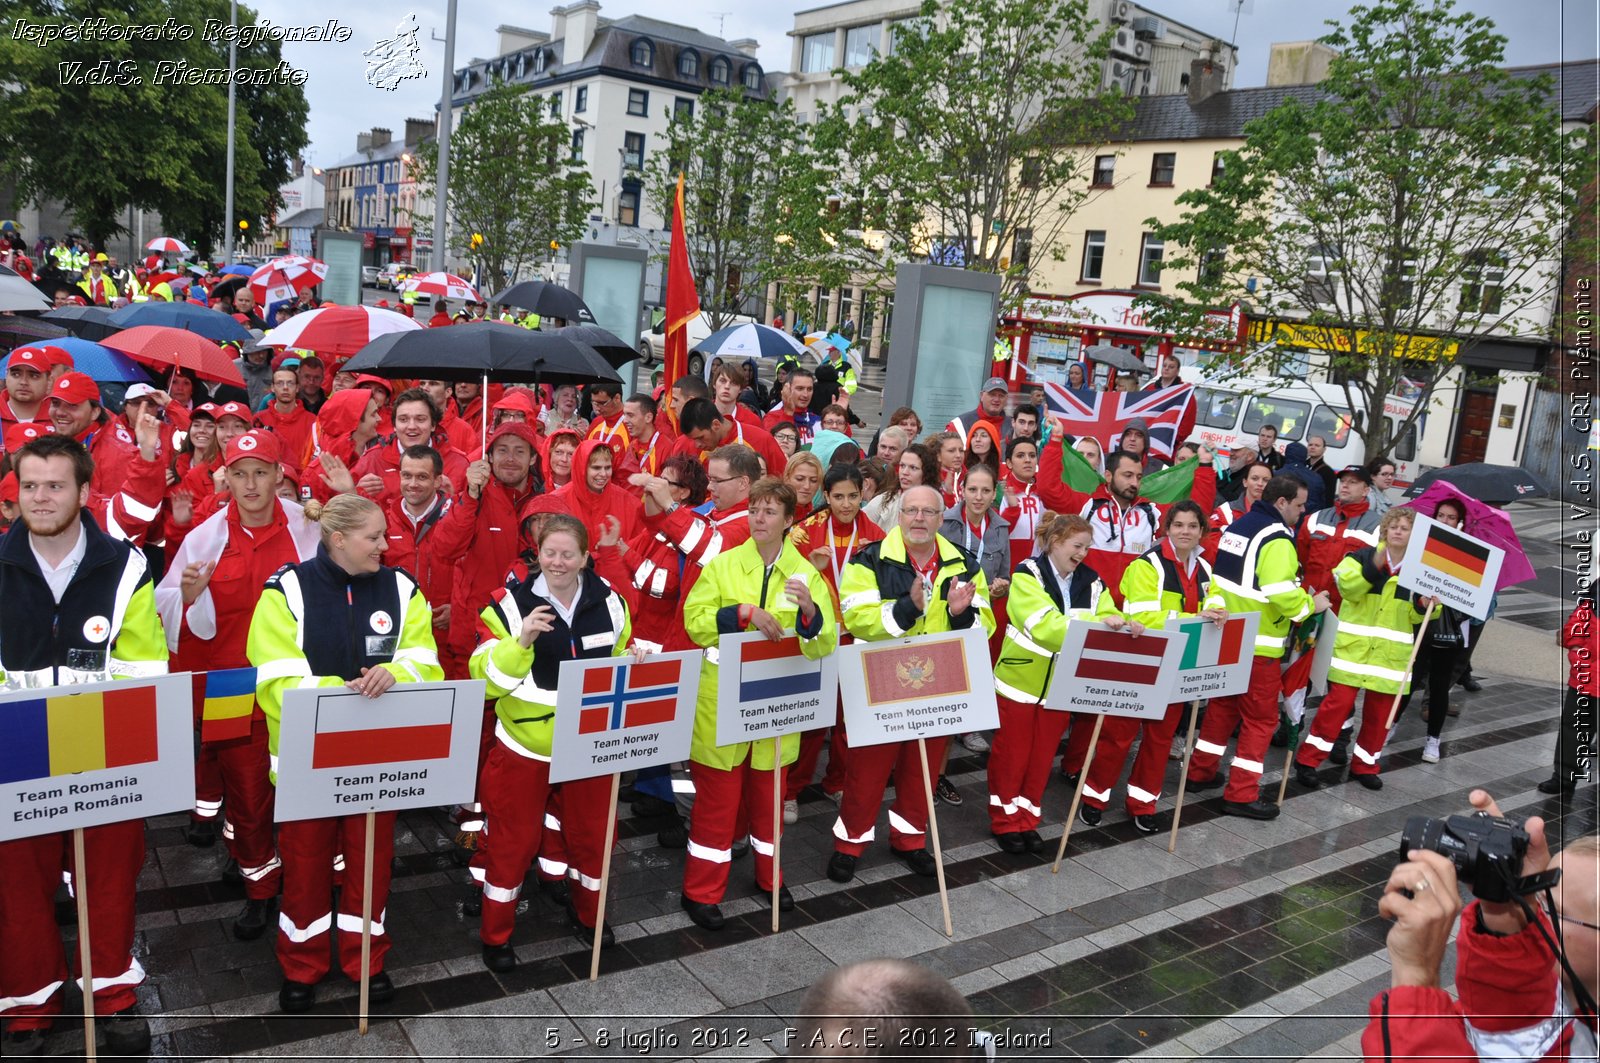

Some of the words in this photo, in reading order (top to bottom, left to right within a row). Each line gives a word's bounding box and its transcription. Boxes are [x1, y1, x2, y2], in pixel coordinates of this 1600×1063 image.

[1200, 431, 1222, 443] IRISH
[1415, 578, 1433, 591] Team
[1434, 585, 1475, 608] Deutschland
[1424, 570, 1442, 583] Team
[1442, 578, 1472, 597] Germany
[1182, 675, 1202, 684] Team
[1204, 671, 1221, 683] Italy
[1085, 685, 1110, 696] Team
[1112, 688, 1138, 699] Latvia
[1180, 686, 1200, 694] Team
[1202, 683, 1219, 693] Italia
[740, 707, 765, 718] Team
[767, 698, 820, 715] Netherlands
[874, 711, 903, 721] Team
[906, 701, 968, 718] Montenegro
[1071, 696, 1112, 708] Komanda
[1115, 700, 1145, 712] Latvija
[743, 721, 768, 732] Team
[771, 712, 815, 728] Nederland
[884, 723, 905, 733] Тим
[908, 719, 934, 734] Црна
[938, 715, 963, 727] Гора
[594, 738, 621, 750] Team
[624, 732, 660, 748] Norway
[592, 749, 626, 764] Teamet
[630, 746, 659, 761] Norge
[334, 775, 374, 787] Team
[380, 768, 427, 783] Poland
[17, 789, 62, 804] Team
[69, 775, 138, 796] Romania
[334, 792, 374, 804] Team
[379, 786, 425, 800] Polska
[14, 804, 68, 822] Echipa
[74, 790, 143, 811] România
